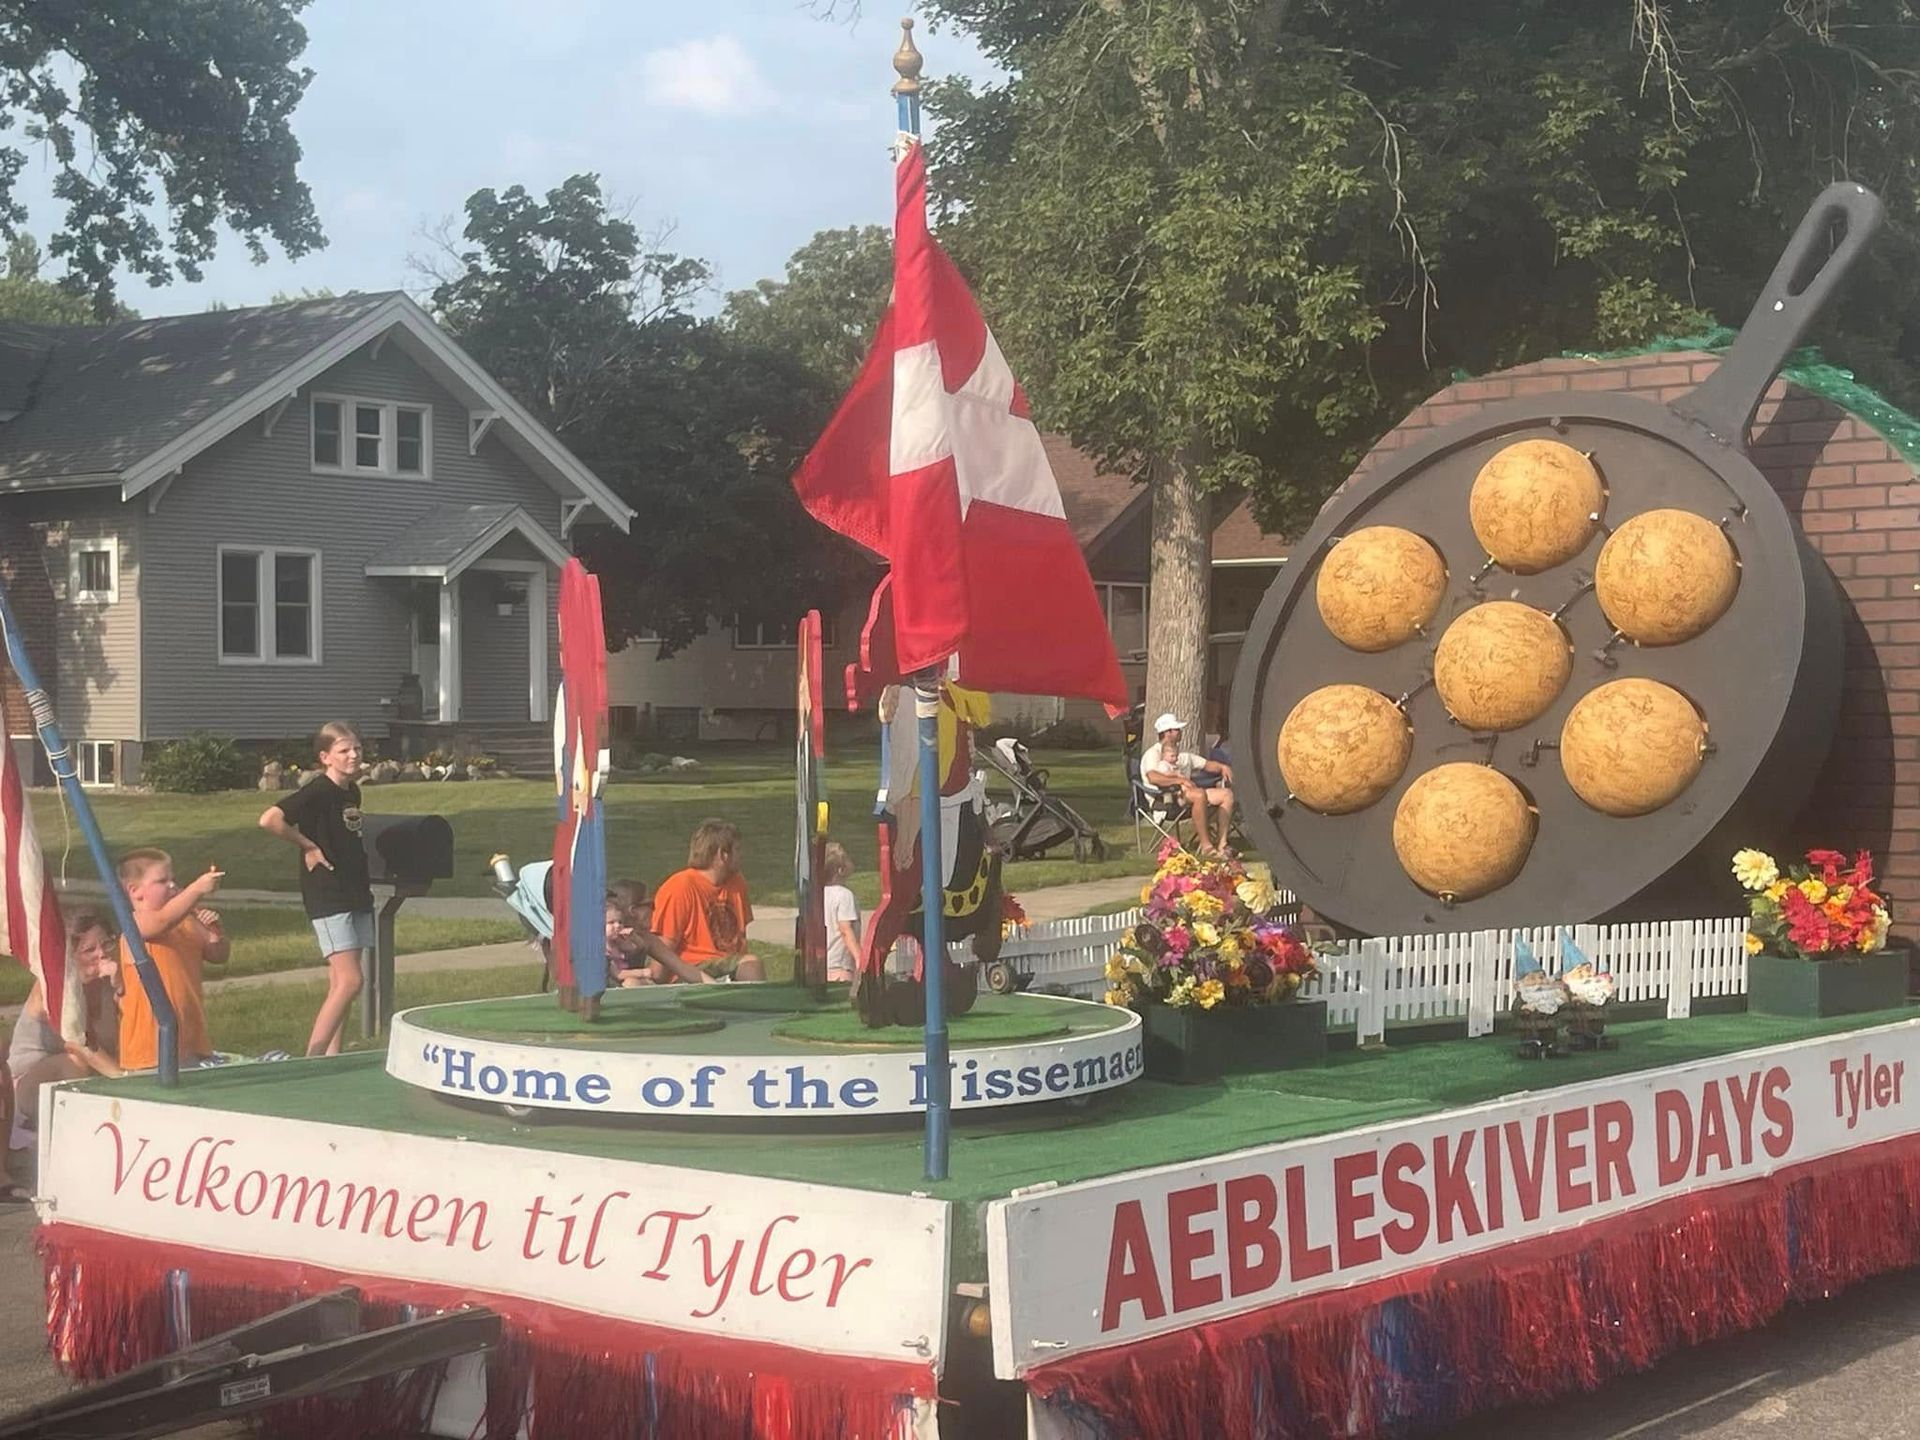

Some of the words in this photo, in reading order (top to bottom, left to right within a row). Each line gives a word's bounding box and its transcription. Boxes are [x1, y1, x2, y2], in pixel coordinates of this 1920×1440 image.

[641, 1066, 725, 1108] of
[748, 1067, 879, 1108] the
[94, 1122, 491, 1252] Velkommen
[522, 1192, 628, 1270] til
[635, 1205, 873, 1320] Tyler
[1103, 1100, 1635, 1331] AEBLESKIVER
[1655, 1065, 1793, 1185] DAYS
[1830, 1052, 1905, 1129] Tyler
